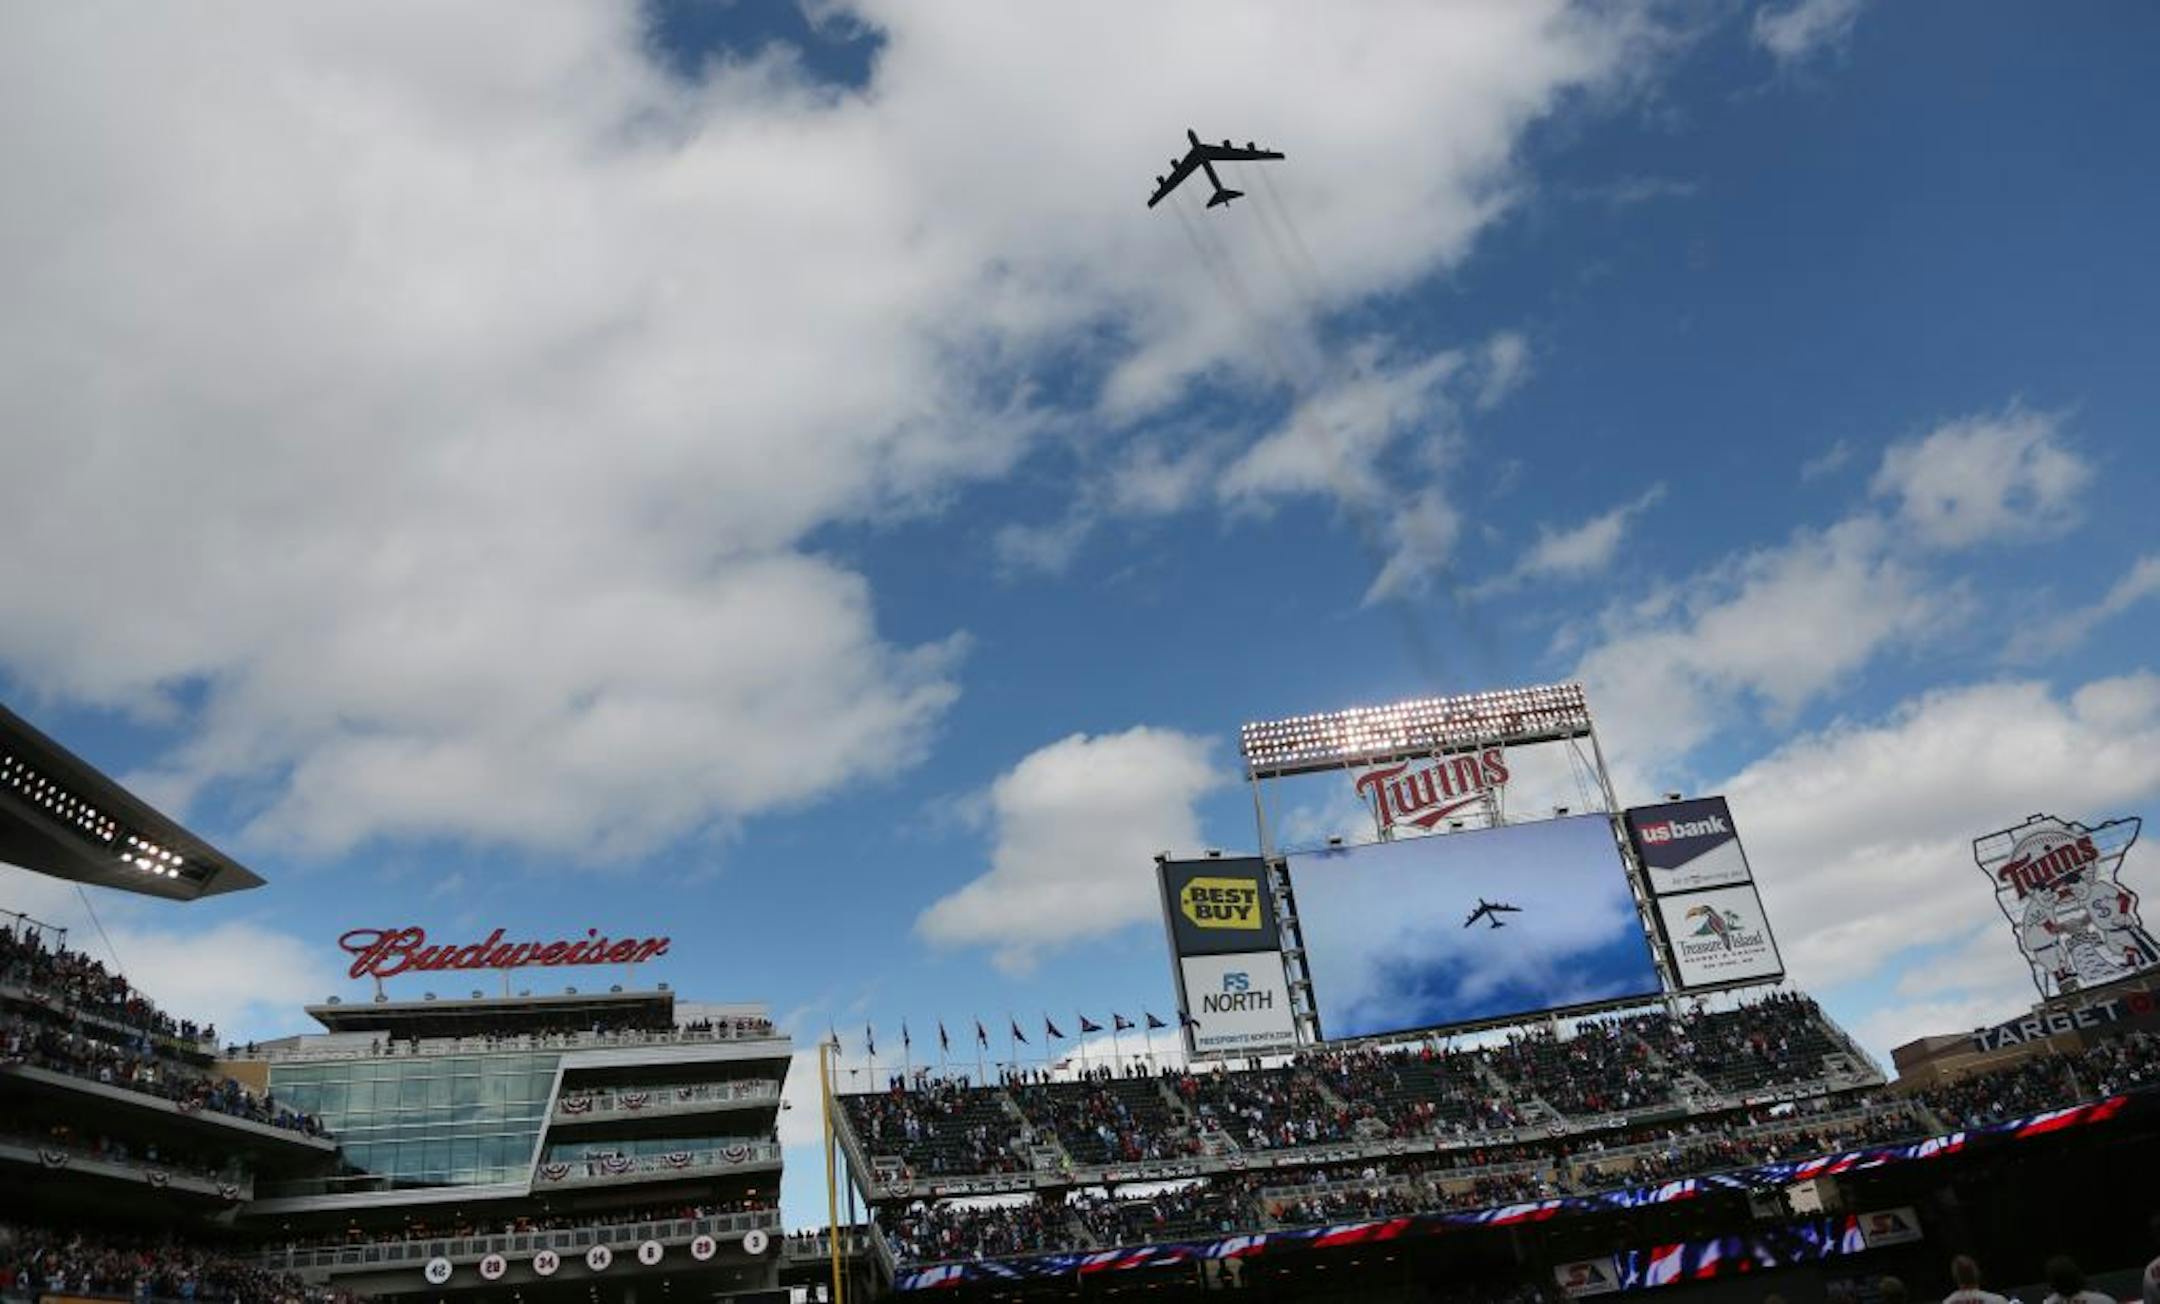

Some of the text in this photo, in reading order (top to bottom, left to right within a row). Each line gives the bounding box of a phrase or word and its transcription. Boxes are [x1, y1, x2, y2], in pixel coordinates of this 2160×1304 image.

[1356, 748, 1509, 828] Twins
[1998, 836, 2099, 899] Twins
[1190, 887, 1255, 903] BEST
[1195, 904, 1252, 920] BUY
[339, 926, 671, 979] Budweiser
[1678, 930, 1764, 956] Treasure Island
[1223, 972, 1249, 991] FS
[1204, 990, 1272, 1013] NORTH
[1971, 999, 2120, 1051] TARGET
[696, 1241, 711, 1254] 29
[752, 1236, 760, 1248] 3
[431, 1264, 446, 1277] 42
[538, 1257, 555, 1269] 34
